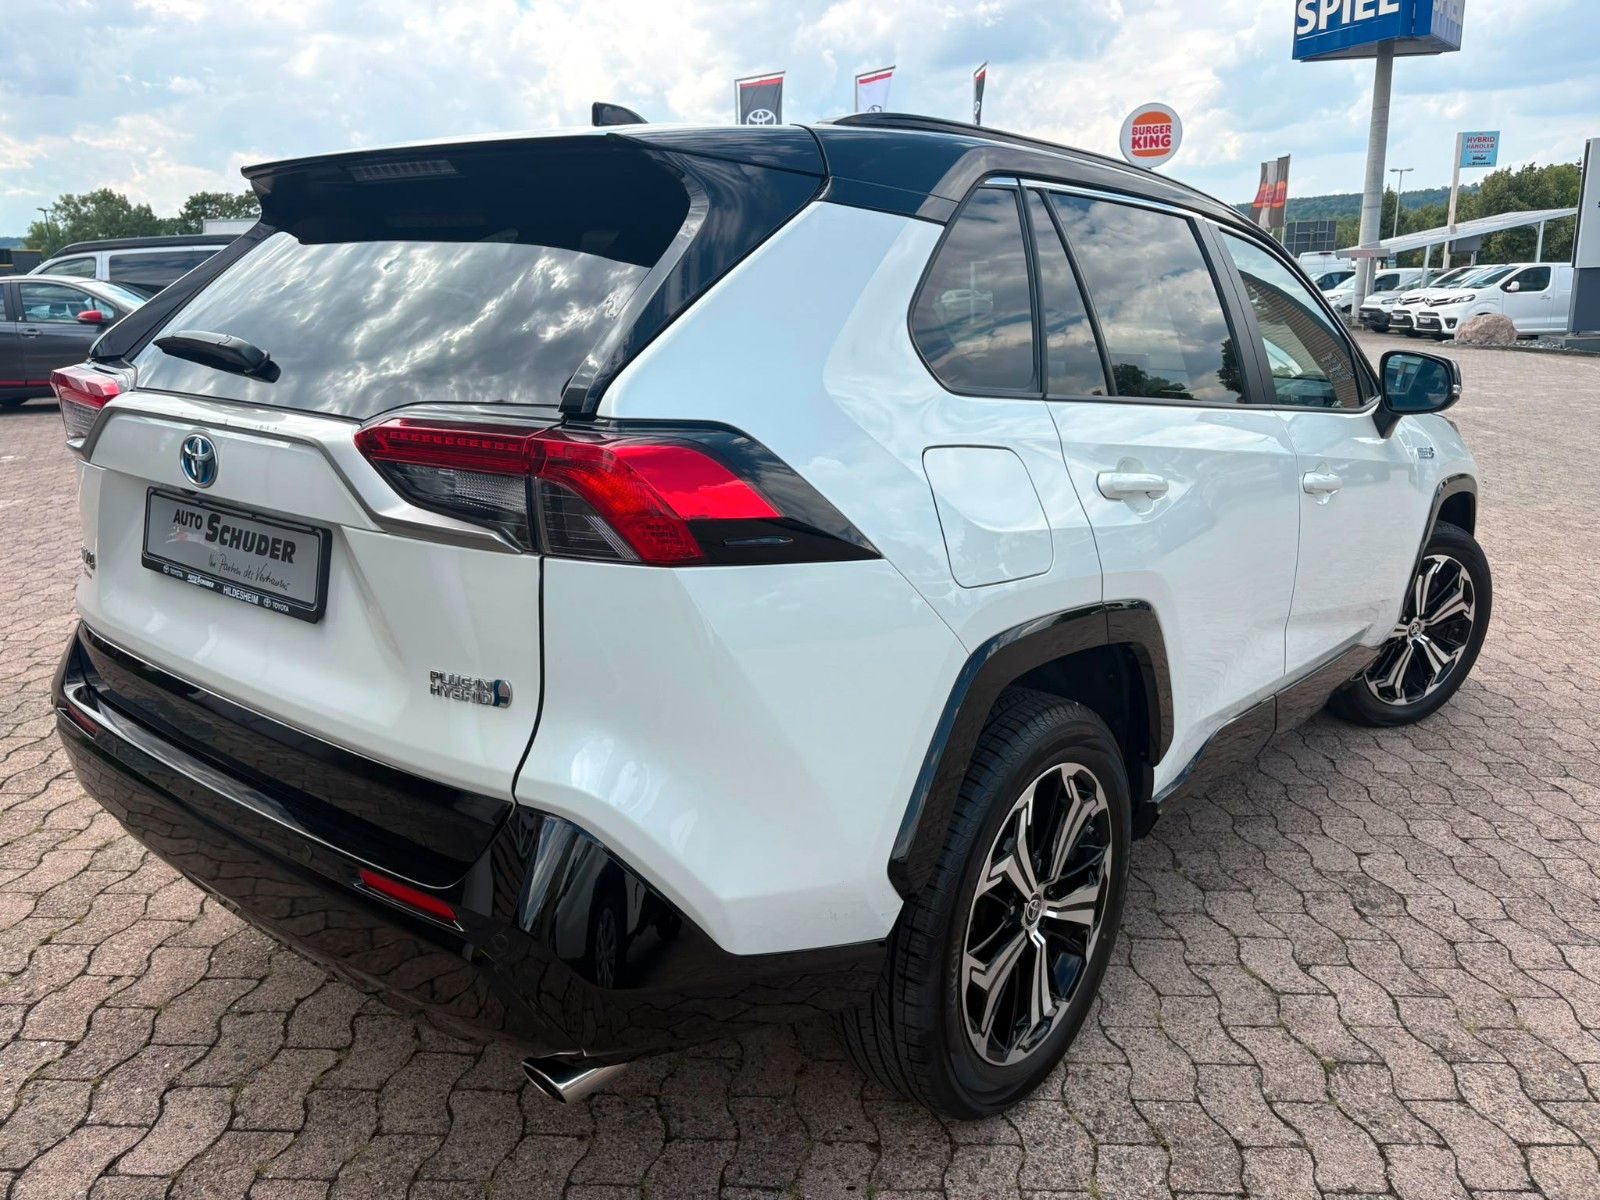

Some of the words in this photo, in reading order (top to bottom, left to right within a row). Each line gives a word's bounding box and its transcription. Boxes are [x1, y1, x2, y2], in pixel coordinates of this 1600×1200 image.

[1132, 125, 1171, 136] BURGER
[1132, 135, 1171, 149] KING
[173, 509, 203, 530] AUTO
[205, 513, 296, 564] SCHUDER
[223, 585, 259, 605] HILDESHEIM
[272, 601, 289, 612] TOYOTA
[430, 684, 493, 706] HYBRID
